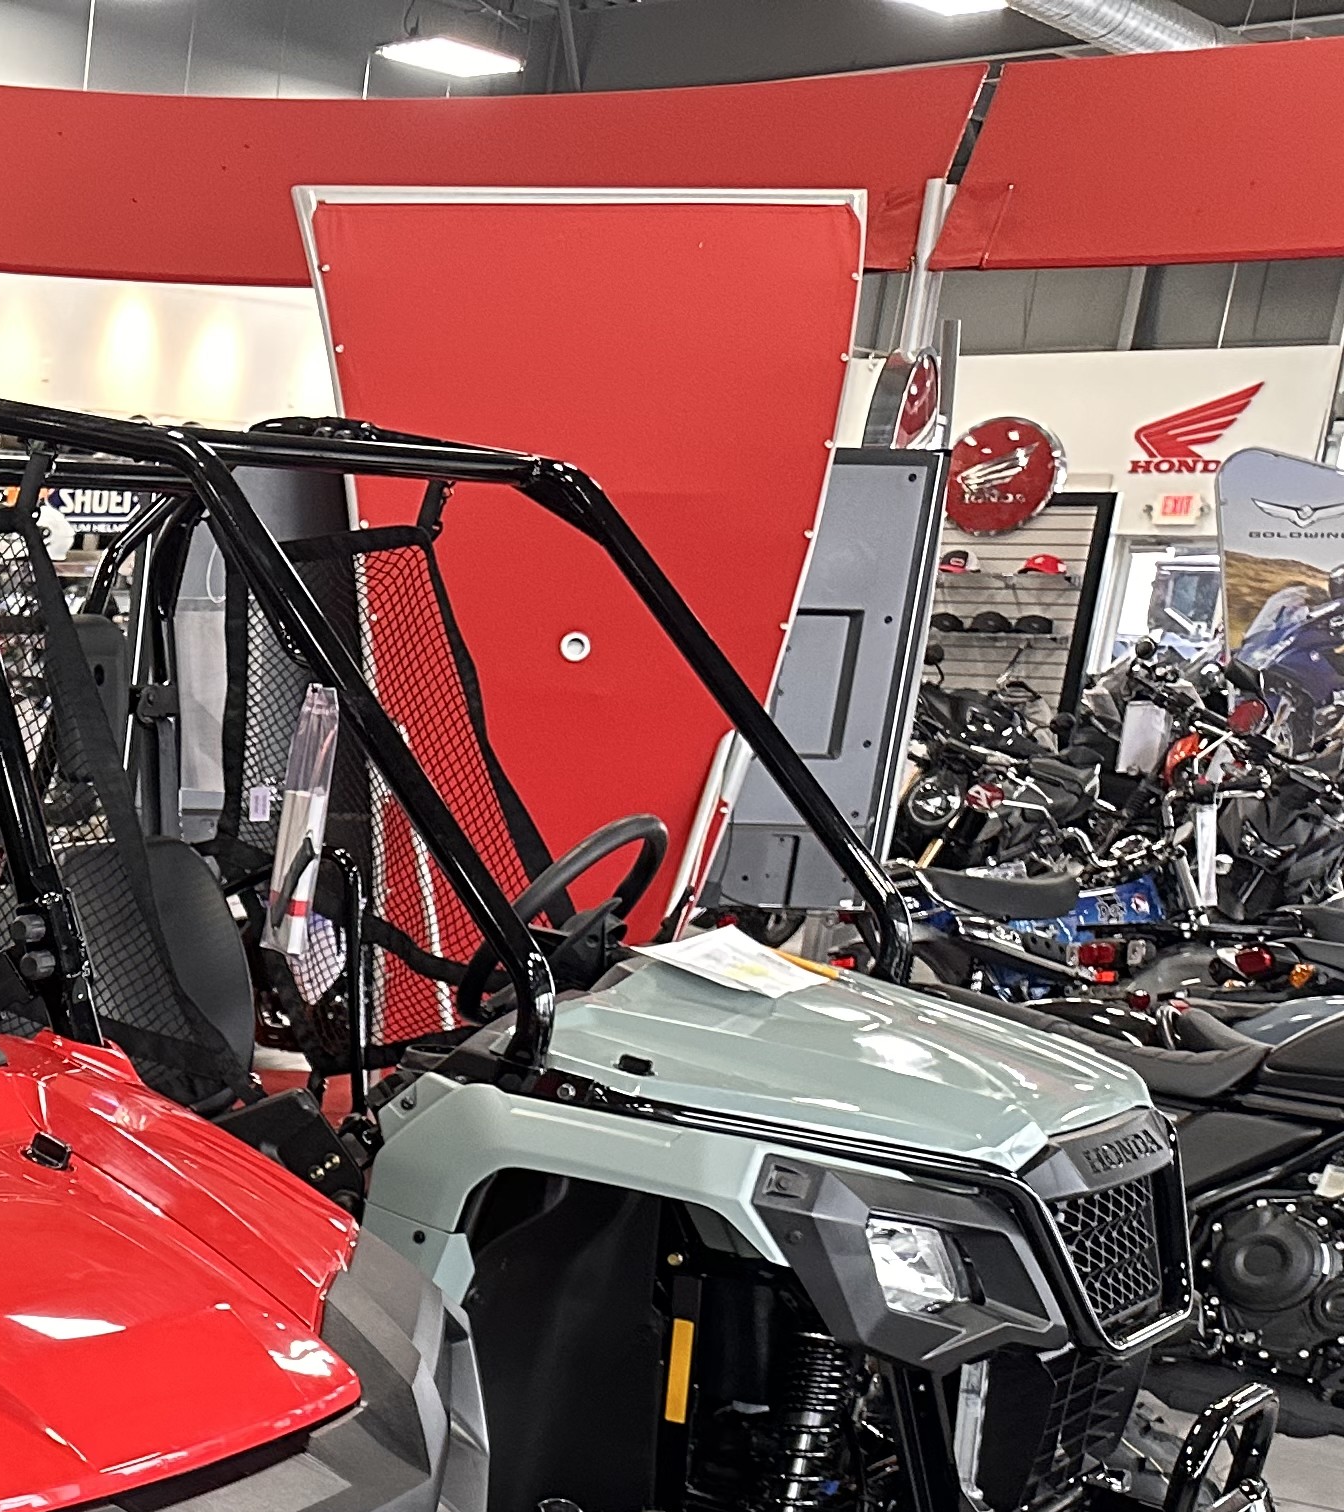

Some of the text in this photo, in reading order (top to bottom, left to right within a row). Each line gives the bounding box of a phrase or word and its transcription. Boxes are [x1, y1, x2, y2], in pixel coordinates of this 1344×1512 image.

[1128, 459, 1222, 474] HOND
[58, 488, 133, 514] SHOEI
[1160, 495, 1194, 517] EXIT
[1248, 531, 1344, 539] GOLDWIN
[1081, 1128, 1164, 1174] HONDA
